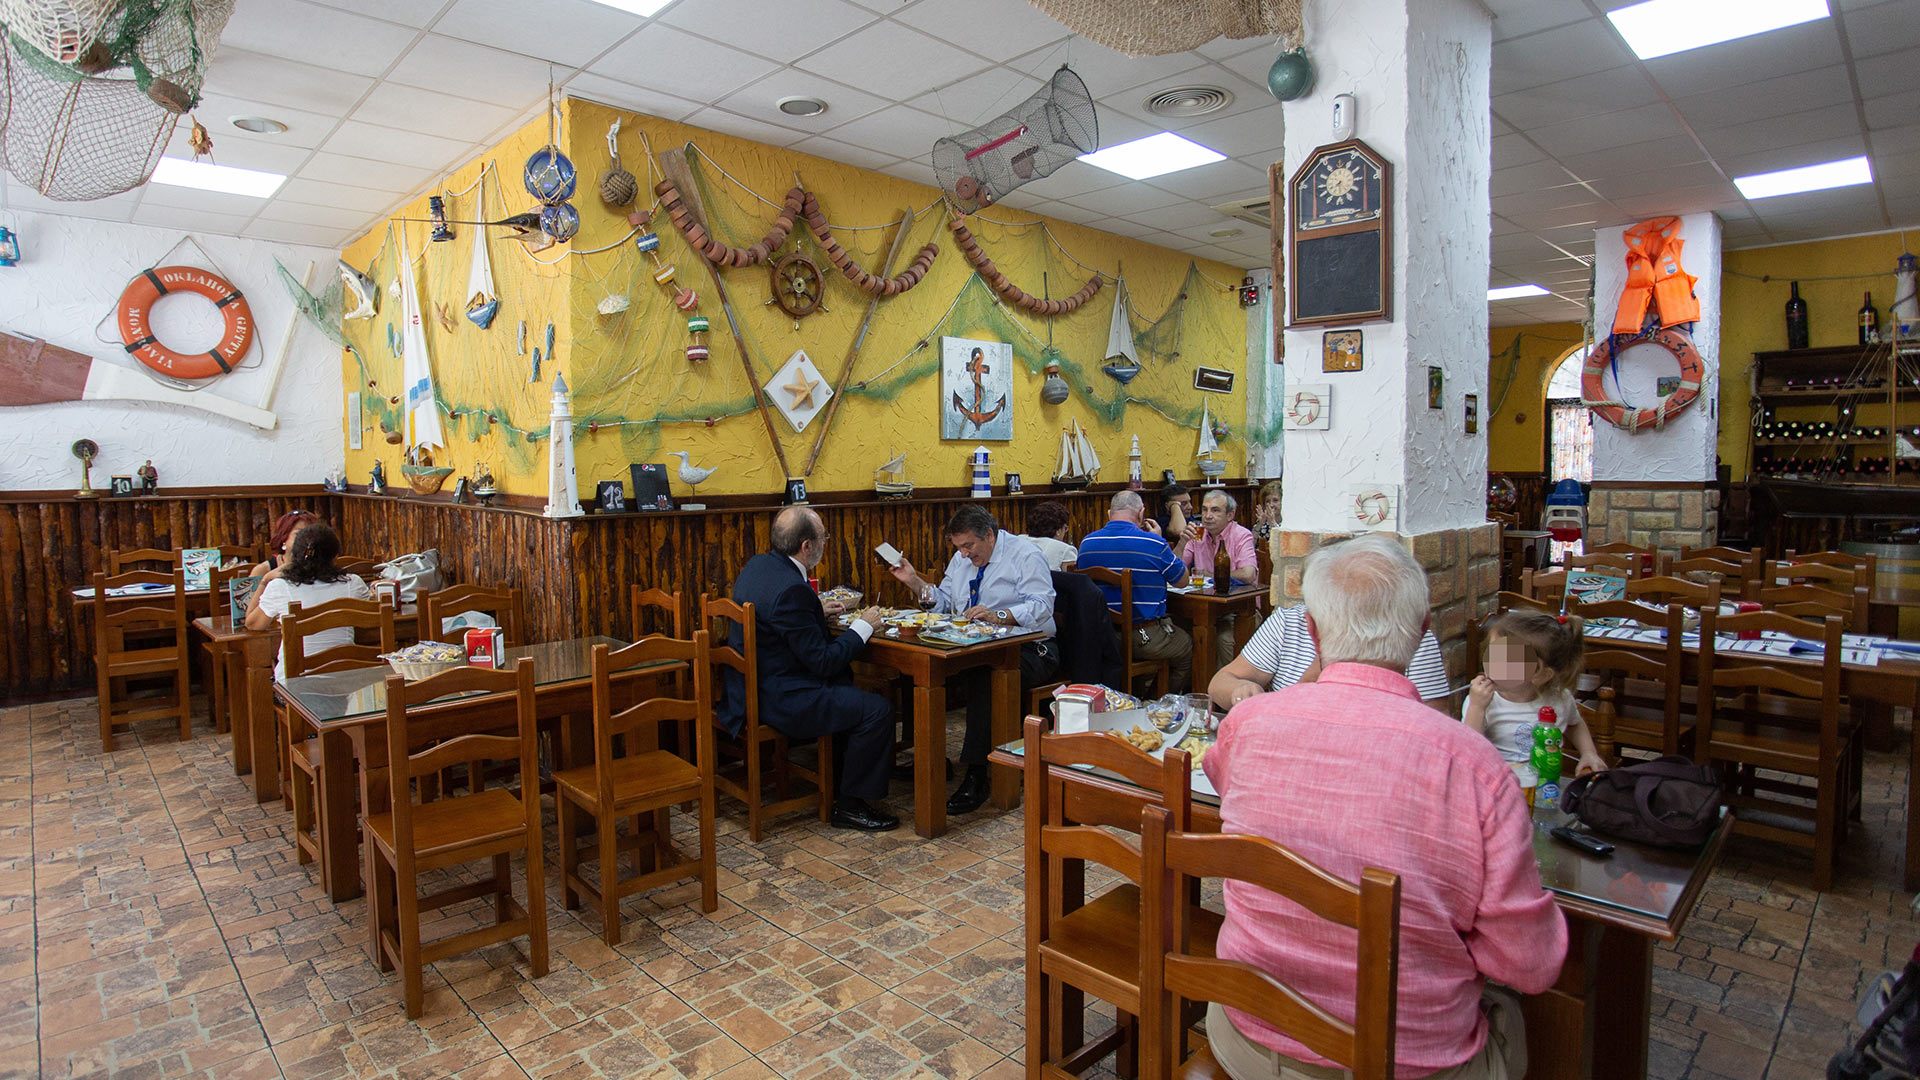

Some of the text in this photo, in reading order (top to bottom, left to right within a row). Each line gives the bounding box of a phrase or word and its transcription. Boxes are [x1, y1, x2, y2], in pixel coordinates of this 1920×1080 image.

[163, 272, 247, 358] OKLAHOMA GETTY
[113, 478, 131, 494] 10
[792, 483, 806, 500] 13
[603, 484, 624, 510] 12
